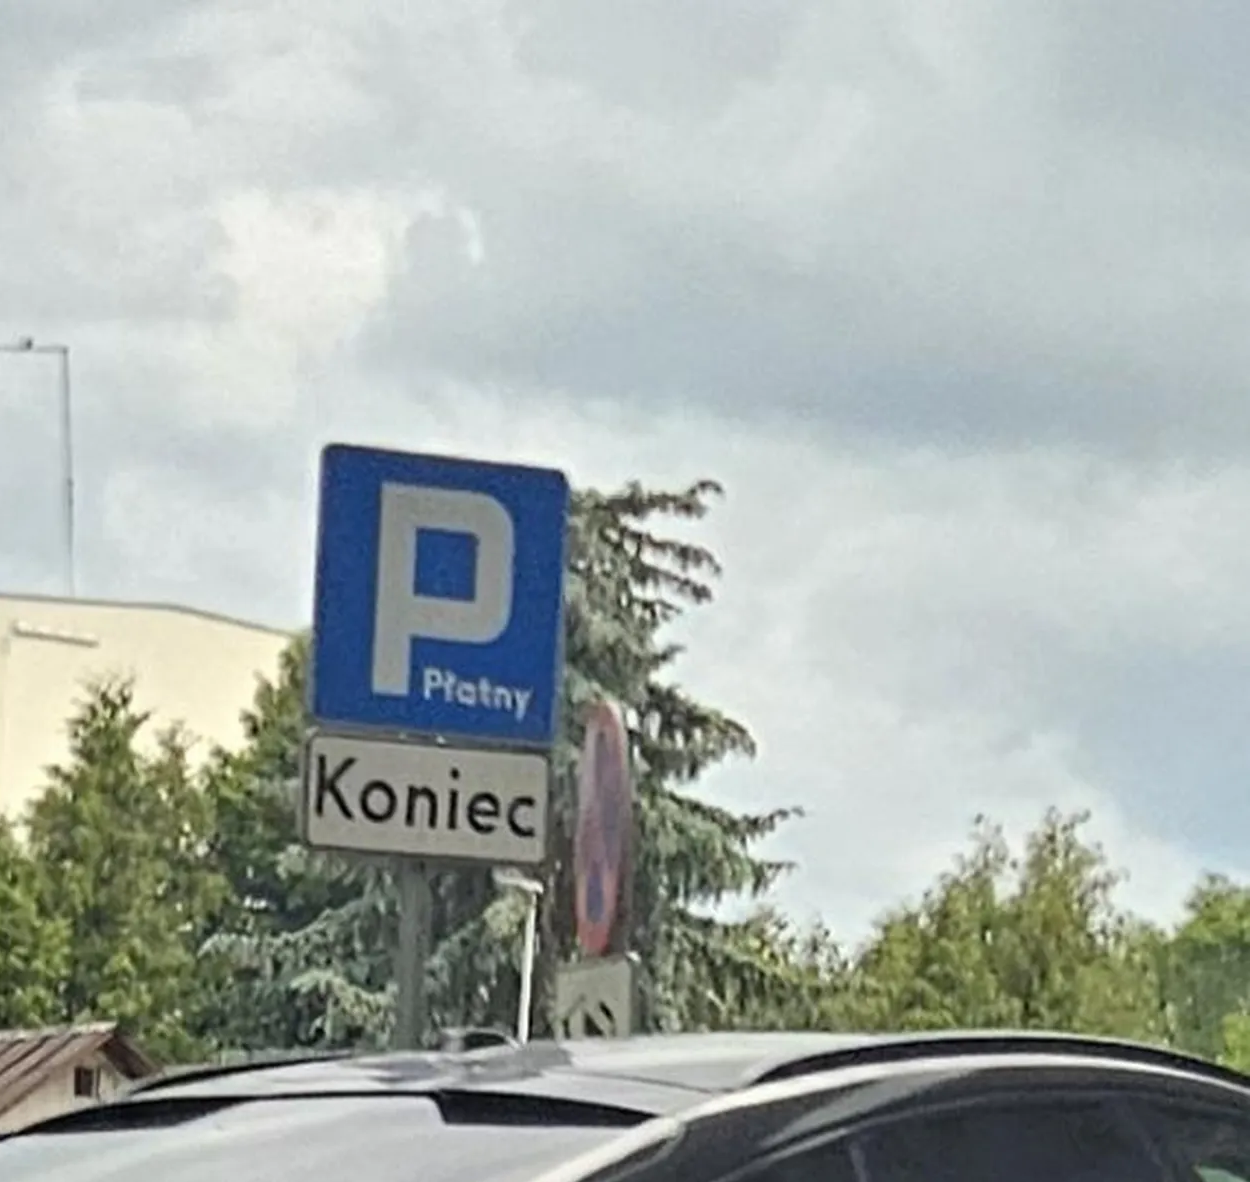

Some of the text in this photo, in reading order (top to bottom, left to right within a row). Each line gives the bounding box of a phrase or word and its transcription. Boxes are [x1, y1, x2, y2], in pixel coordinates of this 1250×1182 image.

[372, 482, 515, 696] P
[423, 667, 533, 720] Płatny
[315, 754, 537, 838] Koniec
